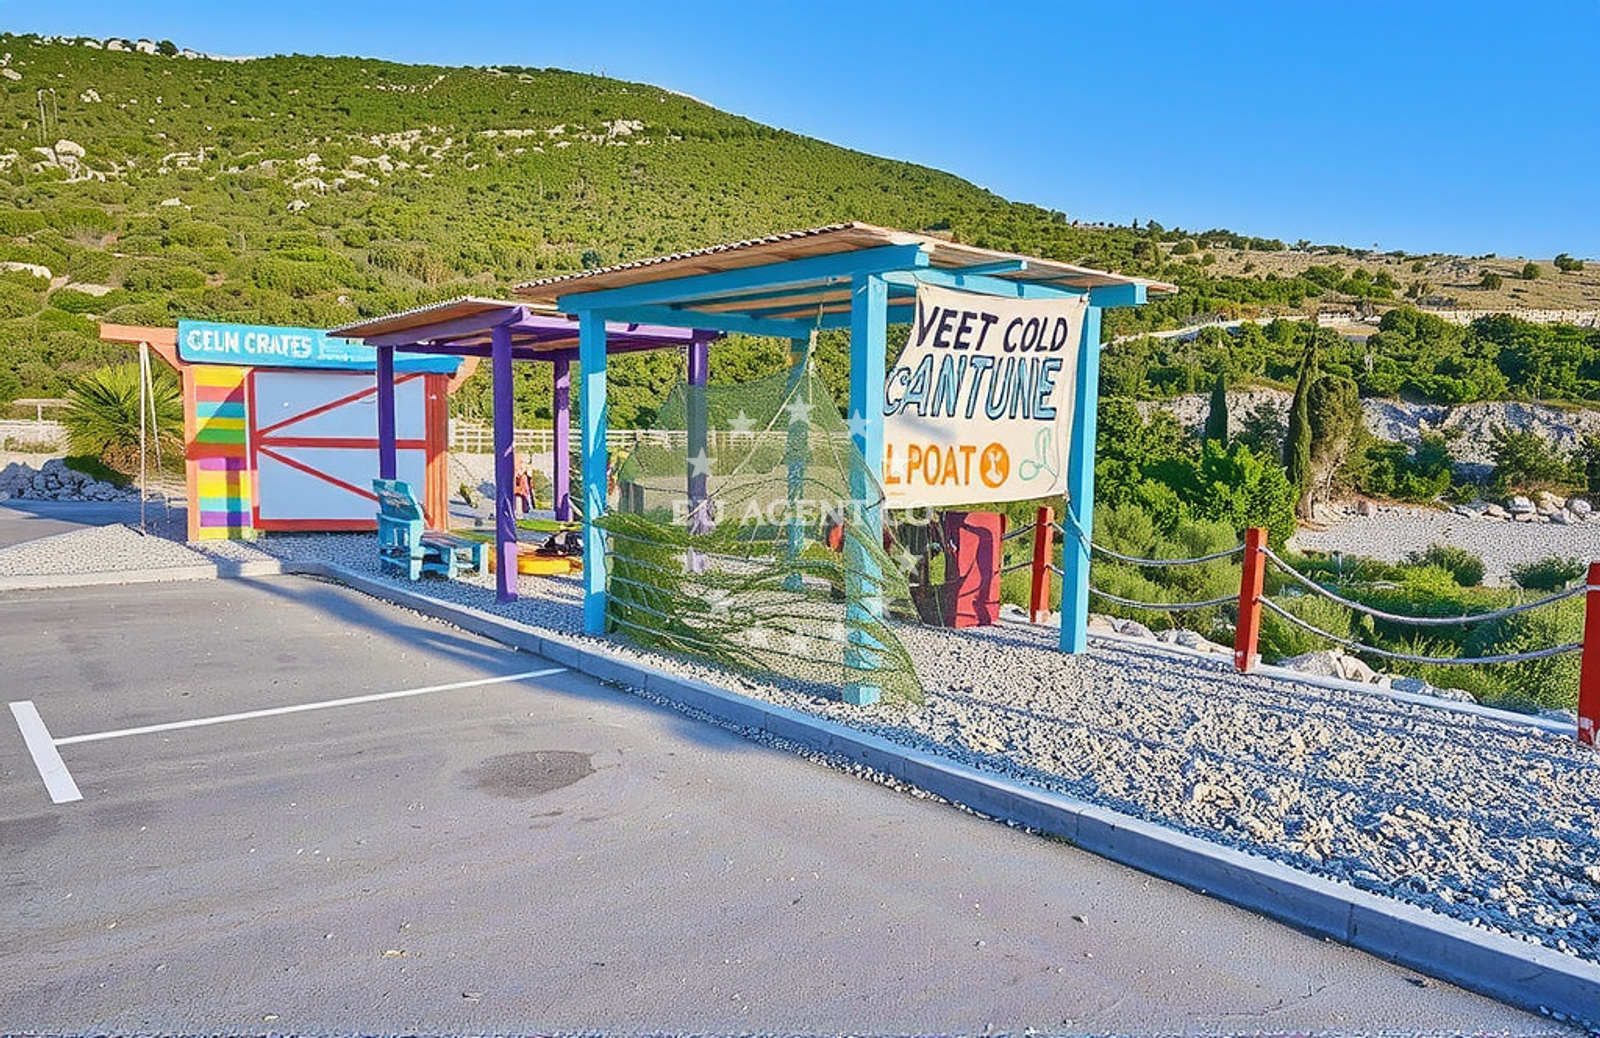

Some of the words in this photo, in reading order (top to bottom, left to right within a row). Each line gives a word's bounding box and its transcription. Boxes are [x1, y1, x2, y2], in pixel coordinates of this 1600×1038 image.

[244, 332, 312, 359] CRATES
[916, 305, 999, 351] VEET
[1003, 316, 1068, 352] COLD
[882, 353, 1063, 420] CANTUNE
[907, 443, 977, 485] POAT
